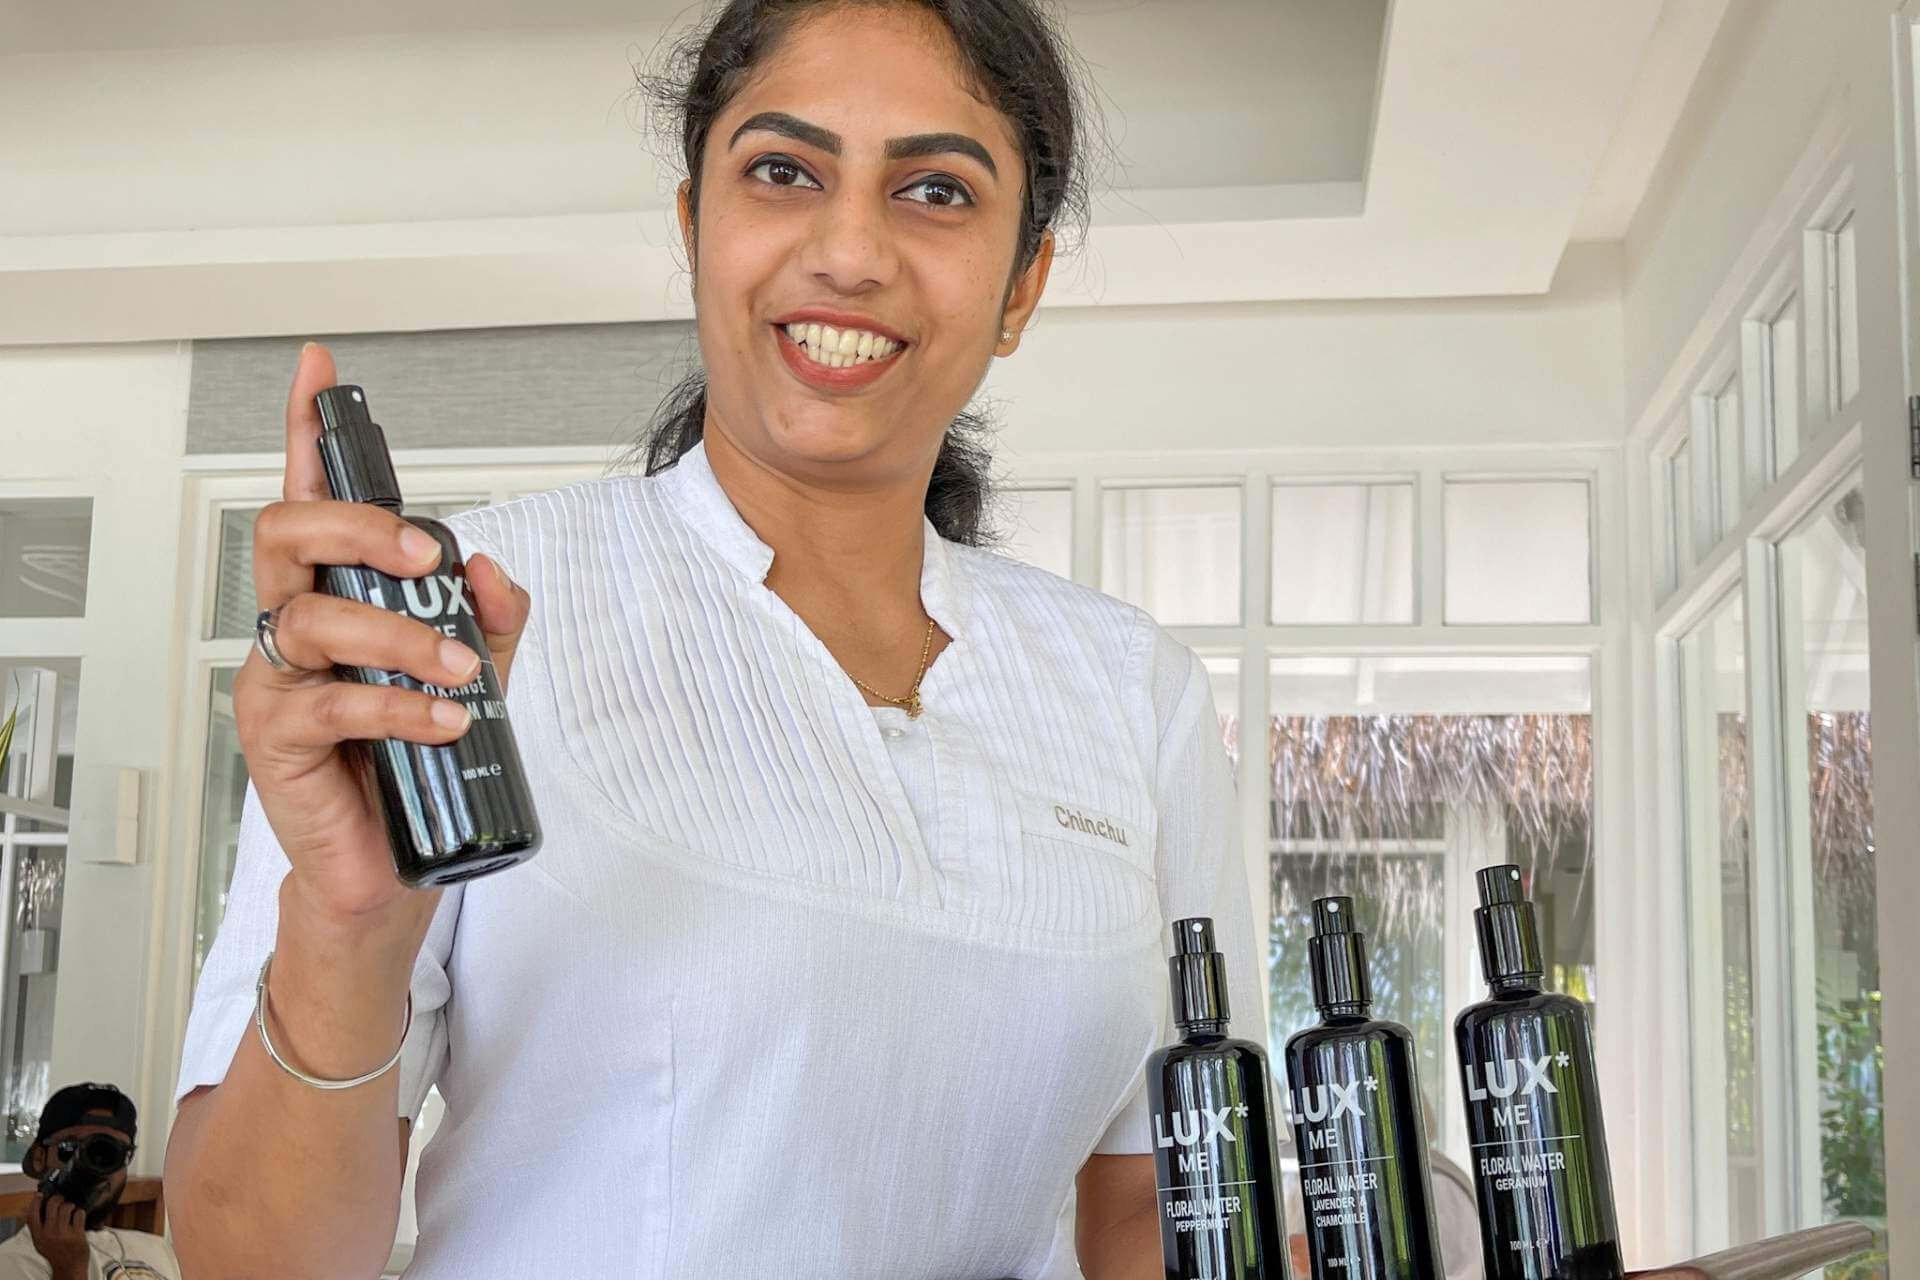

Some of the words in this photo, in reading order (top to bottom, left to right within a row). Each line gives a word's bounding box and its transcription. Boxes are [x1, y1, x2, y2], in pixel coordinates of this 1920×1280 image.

[1055, 805, 1128, 847] Chinchu
[1493, 1104, 1530, 1127] ME
[1308, 1128, 1338, 1150] ME
[1178, 1152, 1210, 1173] ME
[1480, 1156, 1520, 1176] FLORAL
[1521, 1152, 1565, 1173] WATER
[1304, 1176, 1337, 1196] FLORAL
[1336, 1172, 1378, 1192] WATER
[1495, 1175, 1549, 1191] GERANIUM
[1165, 1200, 1202, 1218] FLORAL
[1201, 1196, 1242, 1216] WATER
[1312, 1196, 1356, 1212] LAVENDER
[1316, 1212, 1367, 1228] CHAMOMILE
[1510, 1240, 1521, 1251] 100
